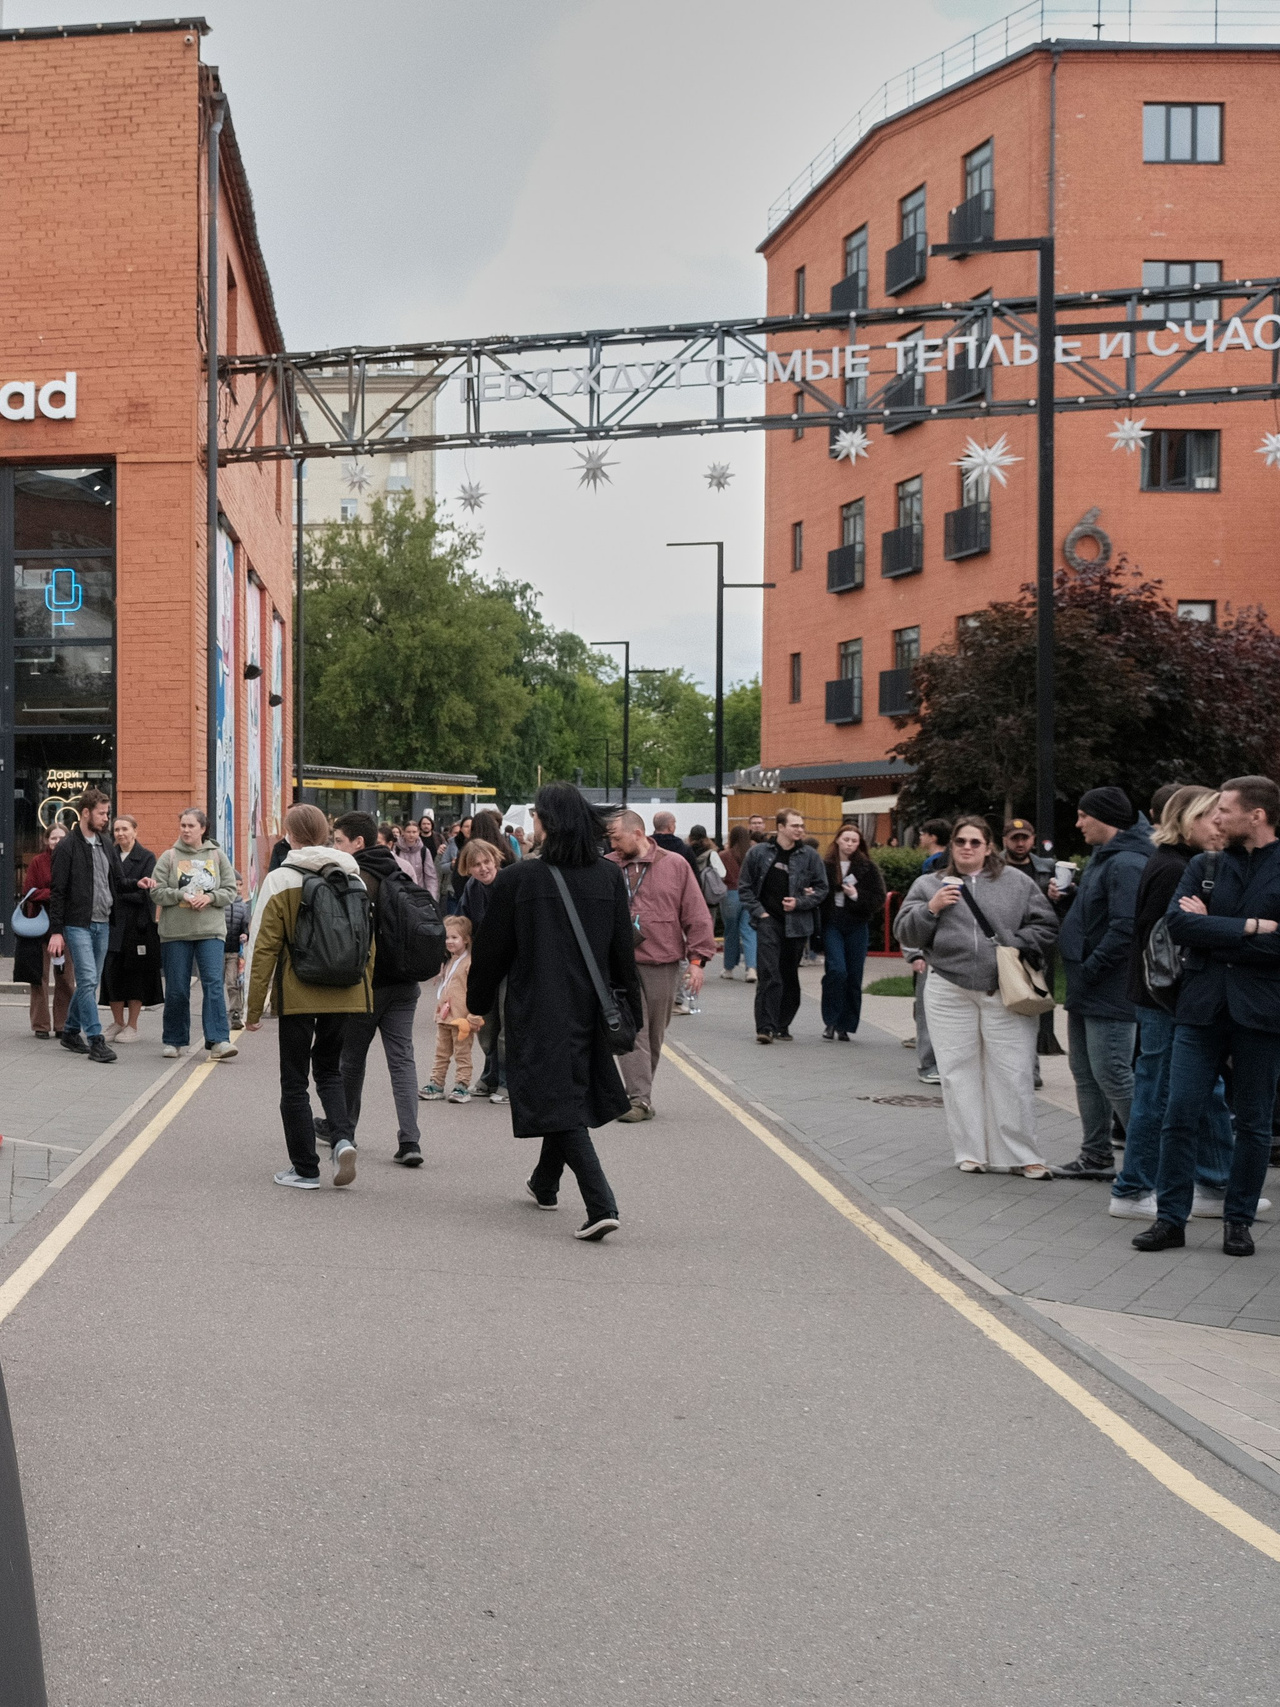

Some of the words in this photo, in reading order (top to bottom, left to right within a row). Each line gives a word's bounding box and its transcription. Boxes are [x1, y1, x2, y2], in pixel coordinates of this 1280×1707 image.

[450, 366, 554, 403] ТЕБЯ
[567, 356, 691, 397] ЖДУТ
[705, 343, 871, 388] САМЫЕ
[46, 769, 79, 781] Дори
[47, 781, 89, 792] музыку
